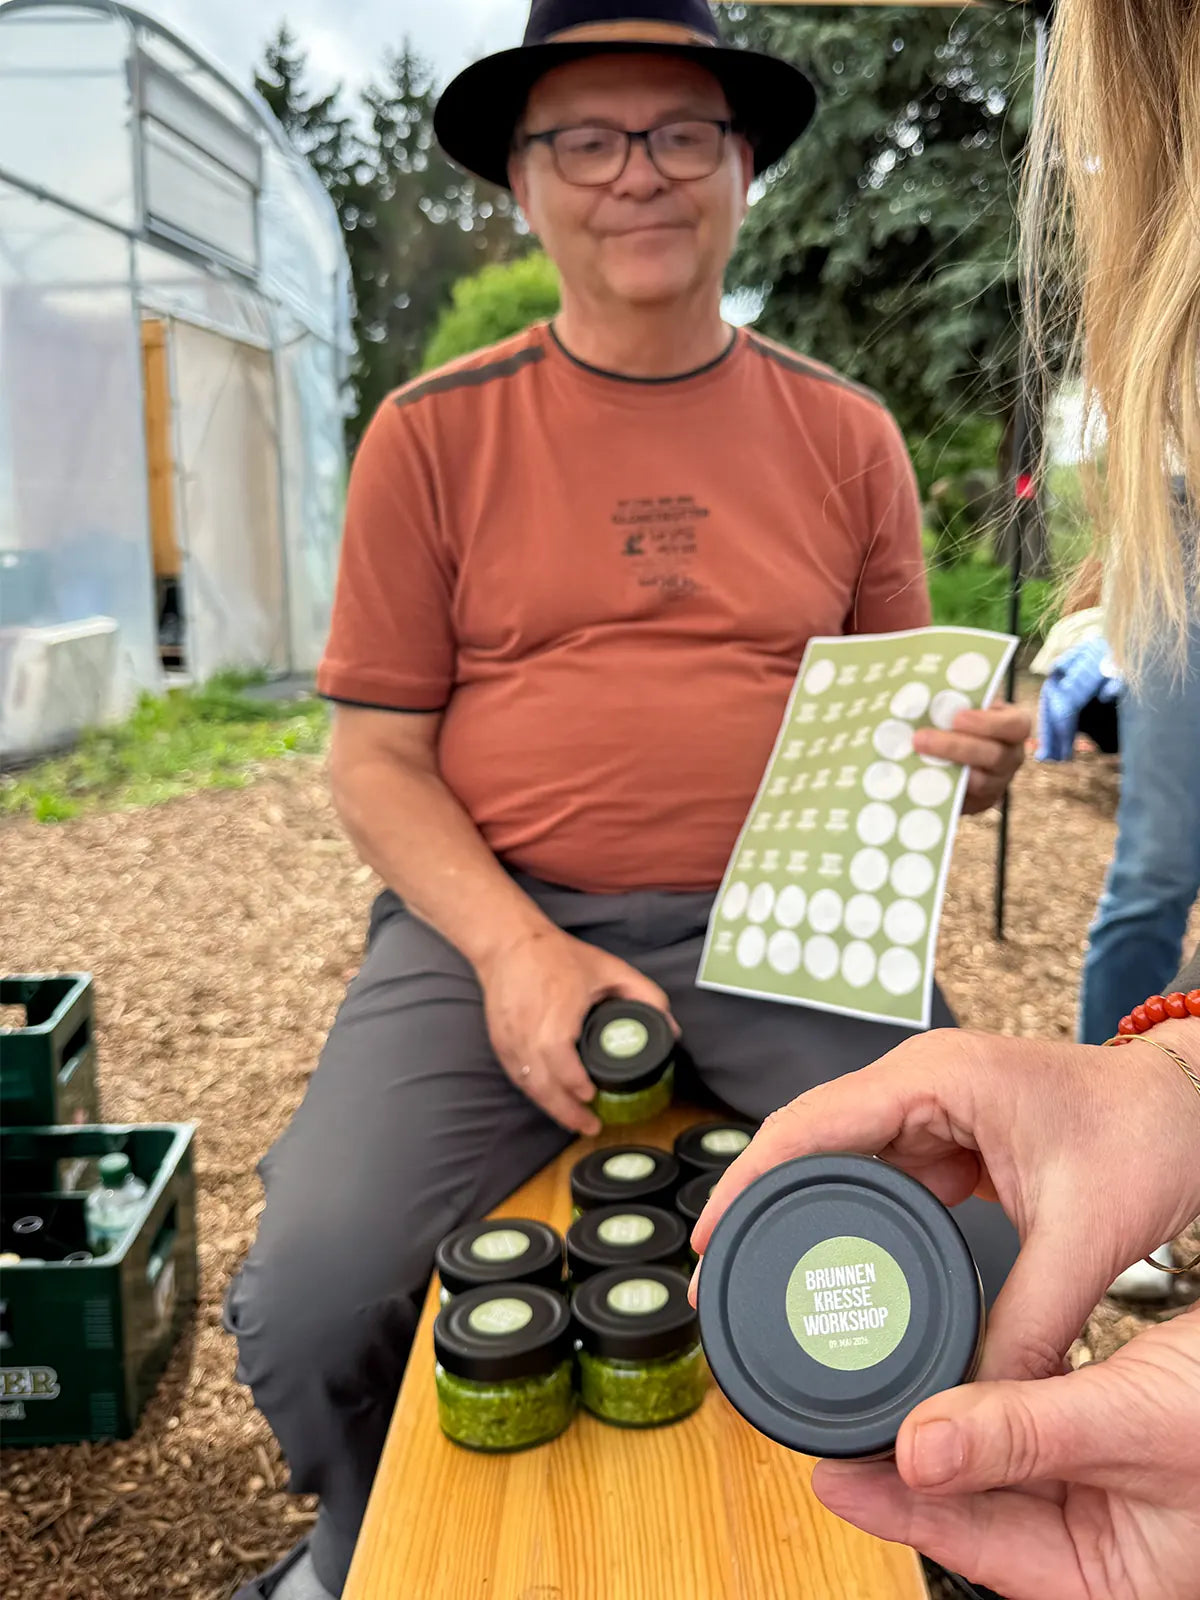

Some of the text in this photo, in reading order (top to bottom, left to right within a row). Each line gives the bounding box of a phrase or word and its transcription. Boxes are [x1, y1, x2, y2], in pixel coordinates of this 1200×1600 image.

[805, 1263, 876, 1290] BRUNNEN
[813, 1286, 873, 1312] KRESSE
[803, 1307, 888, 1336] WORKSHOP
[0, 1372, 53, 1393] ER
